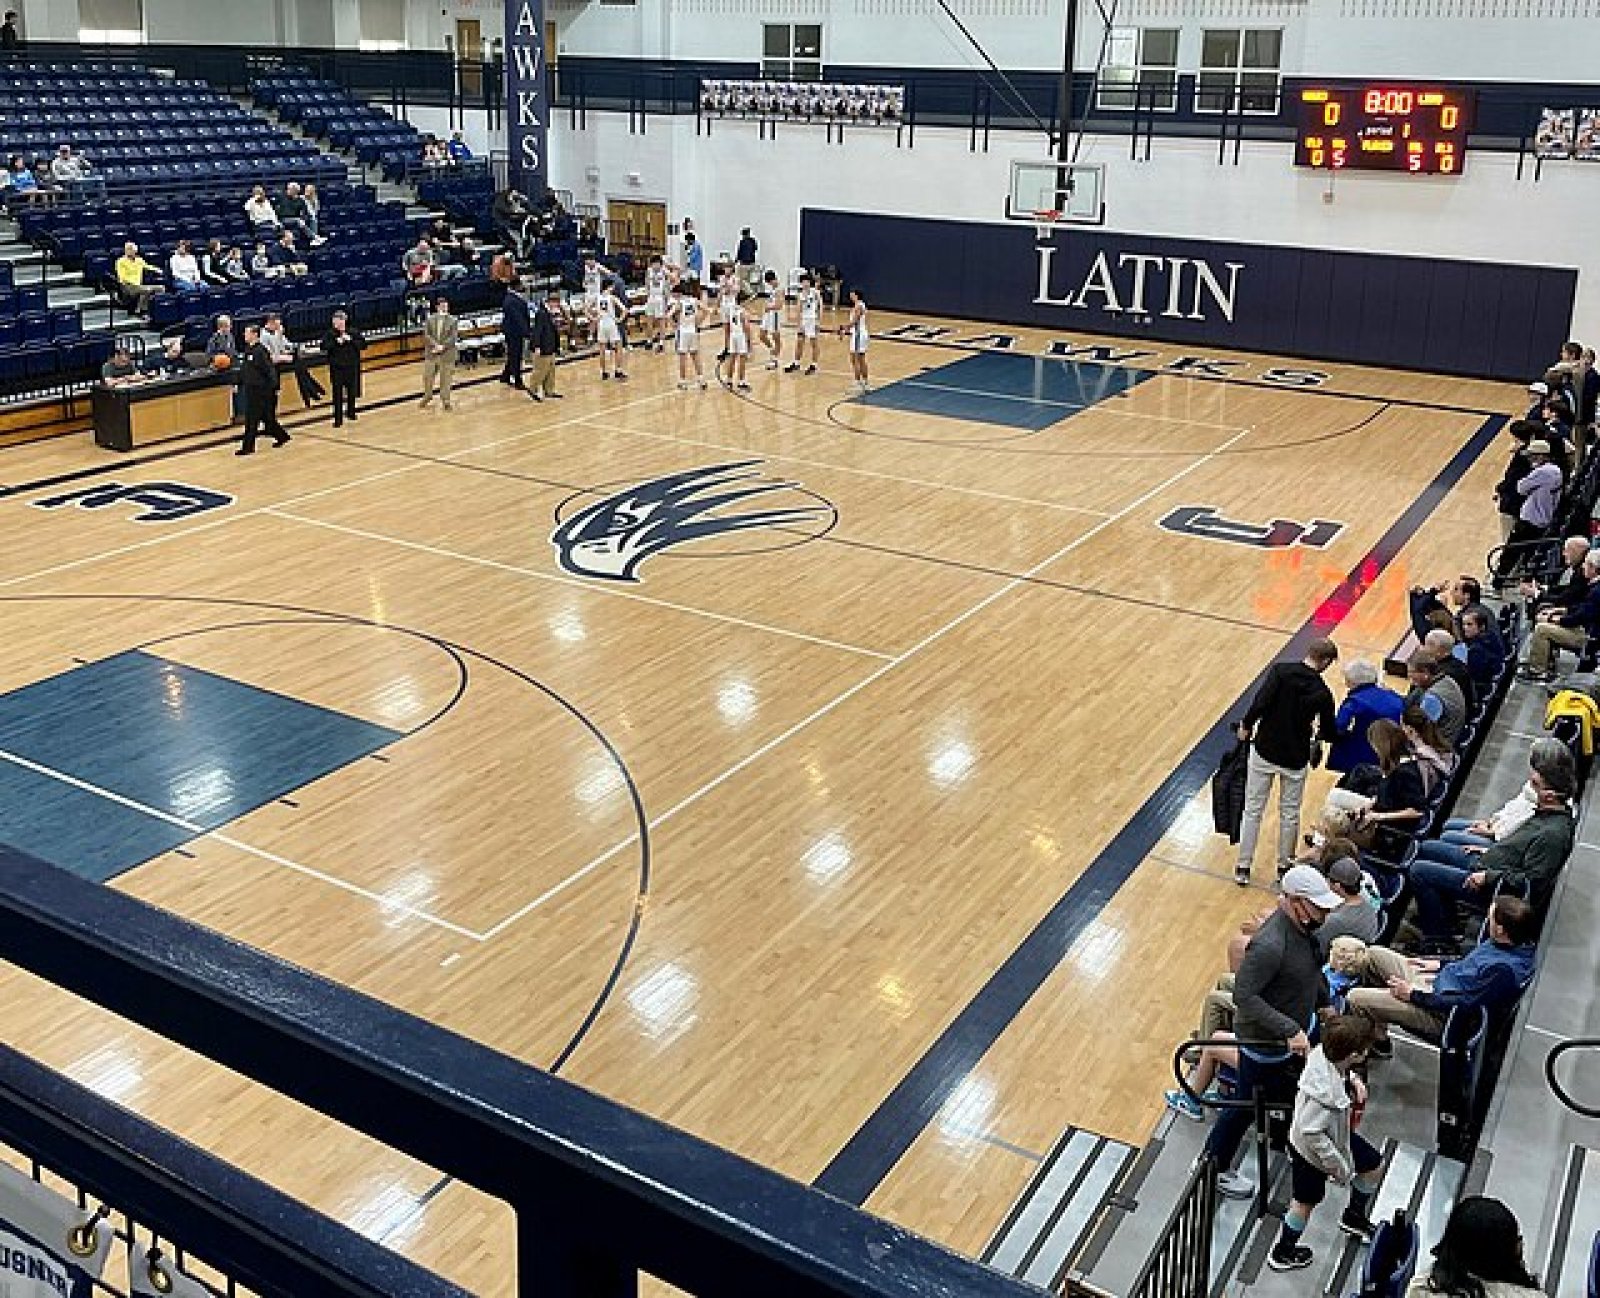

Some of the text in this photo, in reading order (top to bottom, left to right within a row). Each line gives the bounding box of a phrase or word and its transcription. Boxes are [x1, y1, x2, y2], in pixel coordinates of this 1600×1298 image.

[1365, 90, 1413, 114] 8:00
[1324, 102, 1458, 130] 0 0
[1402, 122, 1411, 139] 1
[1311, 149, 1453, 173] 0 5 5 0
[1033, 247, 1244, 322] LATIN
[882, 323, 1331, 387] HAWKS
